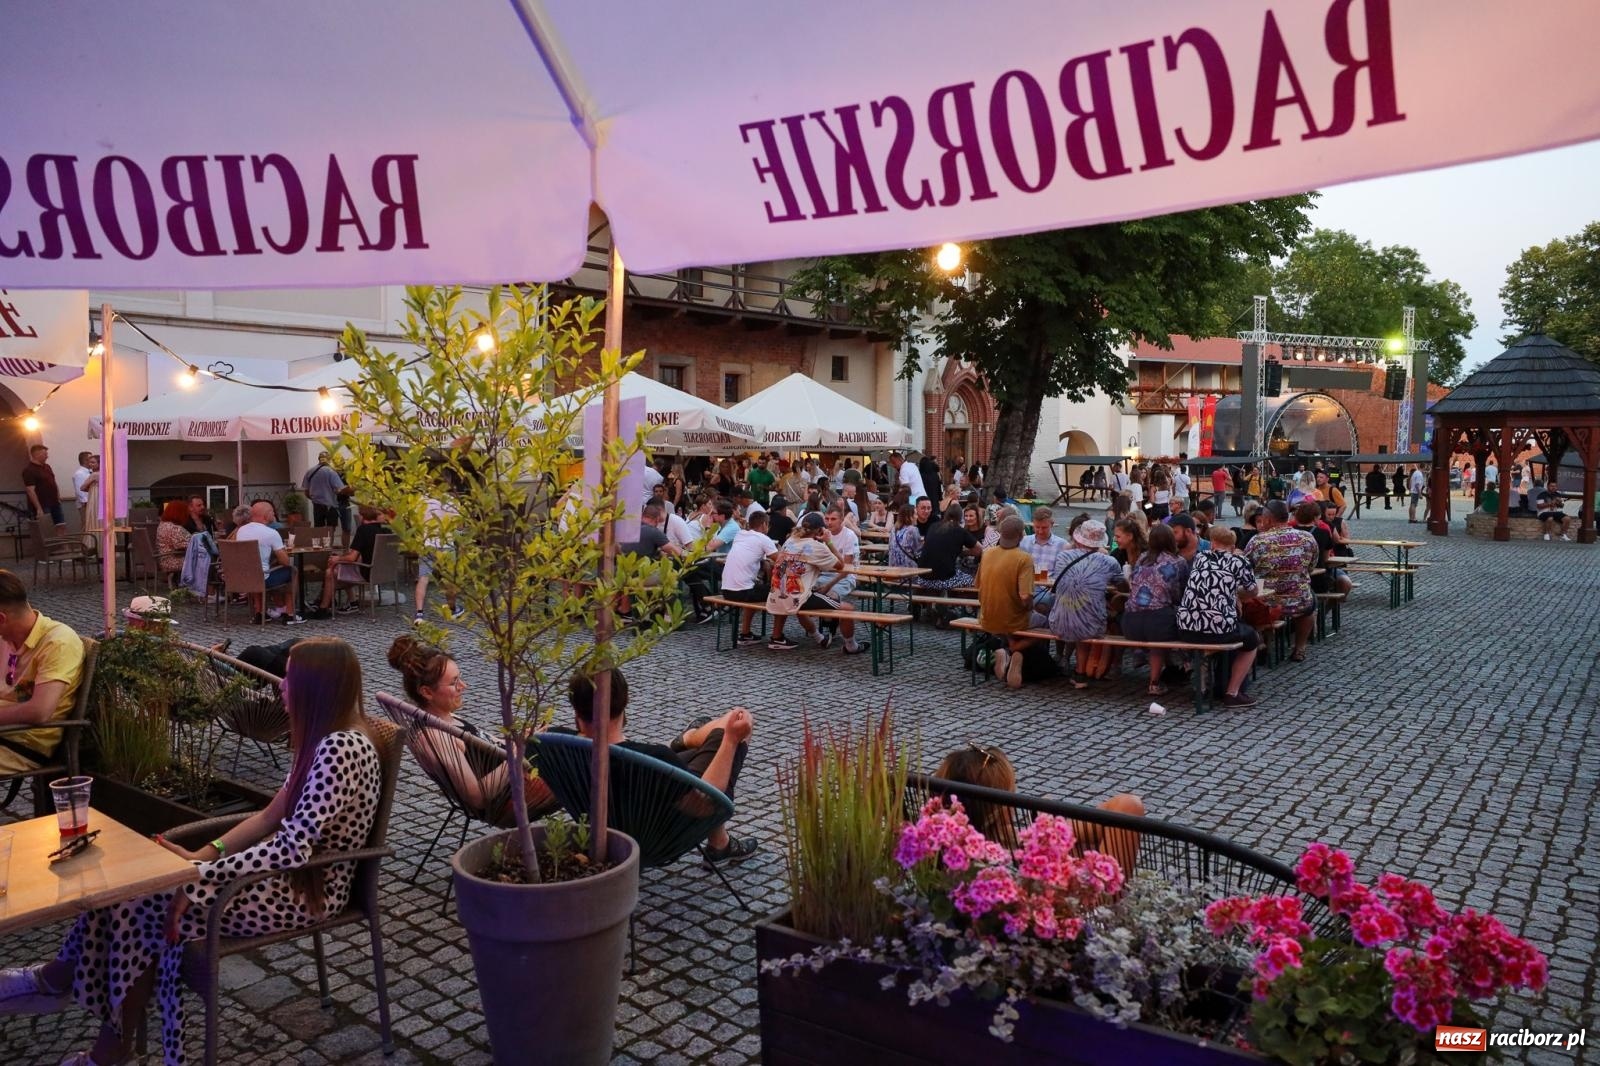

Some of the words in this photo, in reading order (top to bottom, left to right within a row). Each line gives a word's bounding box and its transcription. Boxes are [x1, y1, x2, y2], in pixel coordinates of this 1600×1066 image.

[112, 421, 171, 436] IBORSKIE
[188, 420, 228, 437] RACIBORSKIE
[270, 412, 363, 434] RACIBORSKE
[838, 431, 888, 443] RACIBORSKIE
